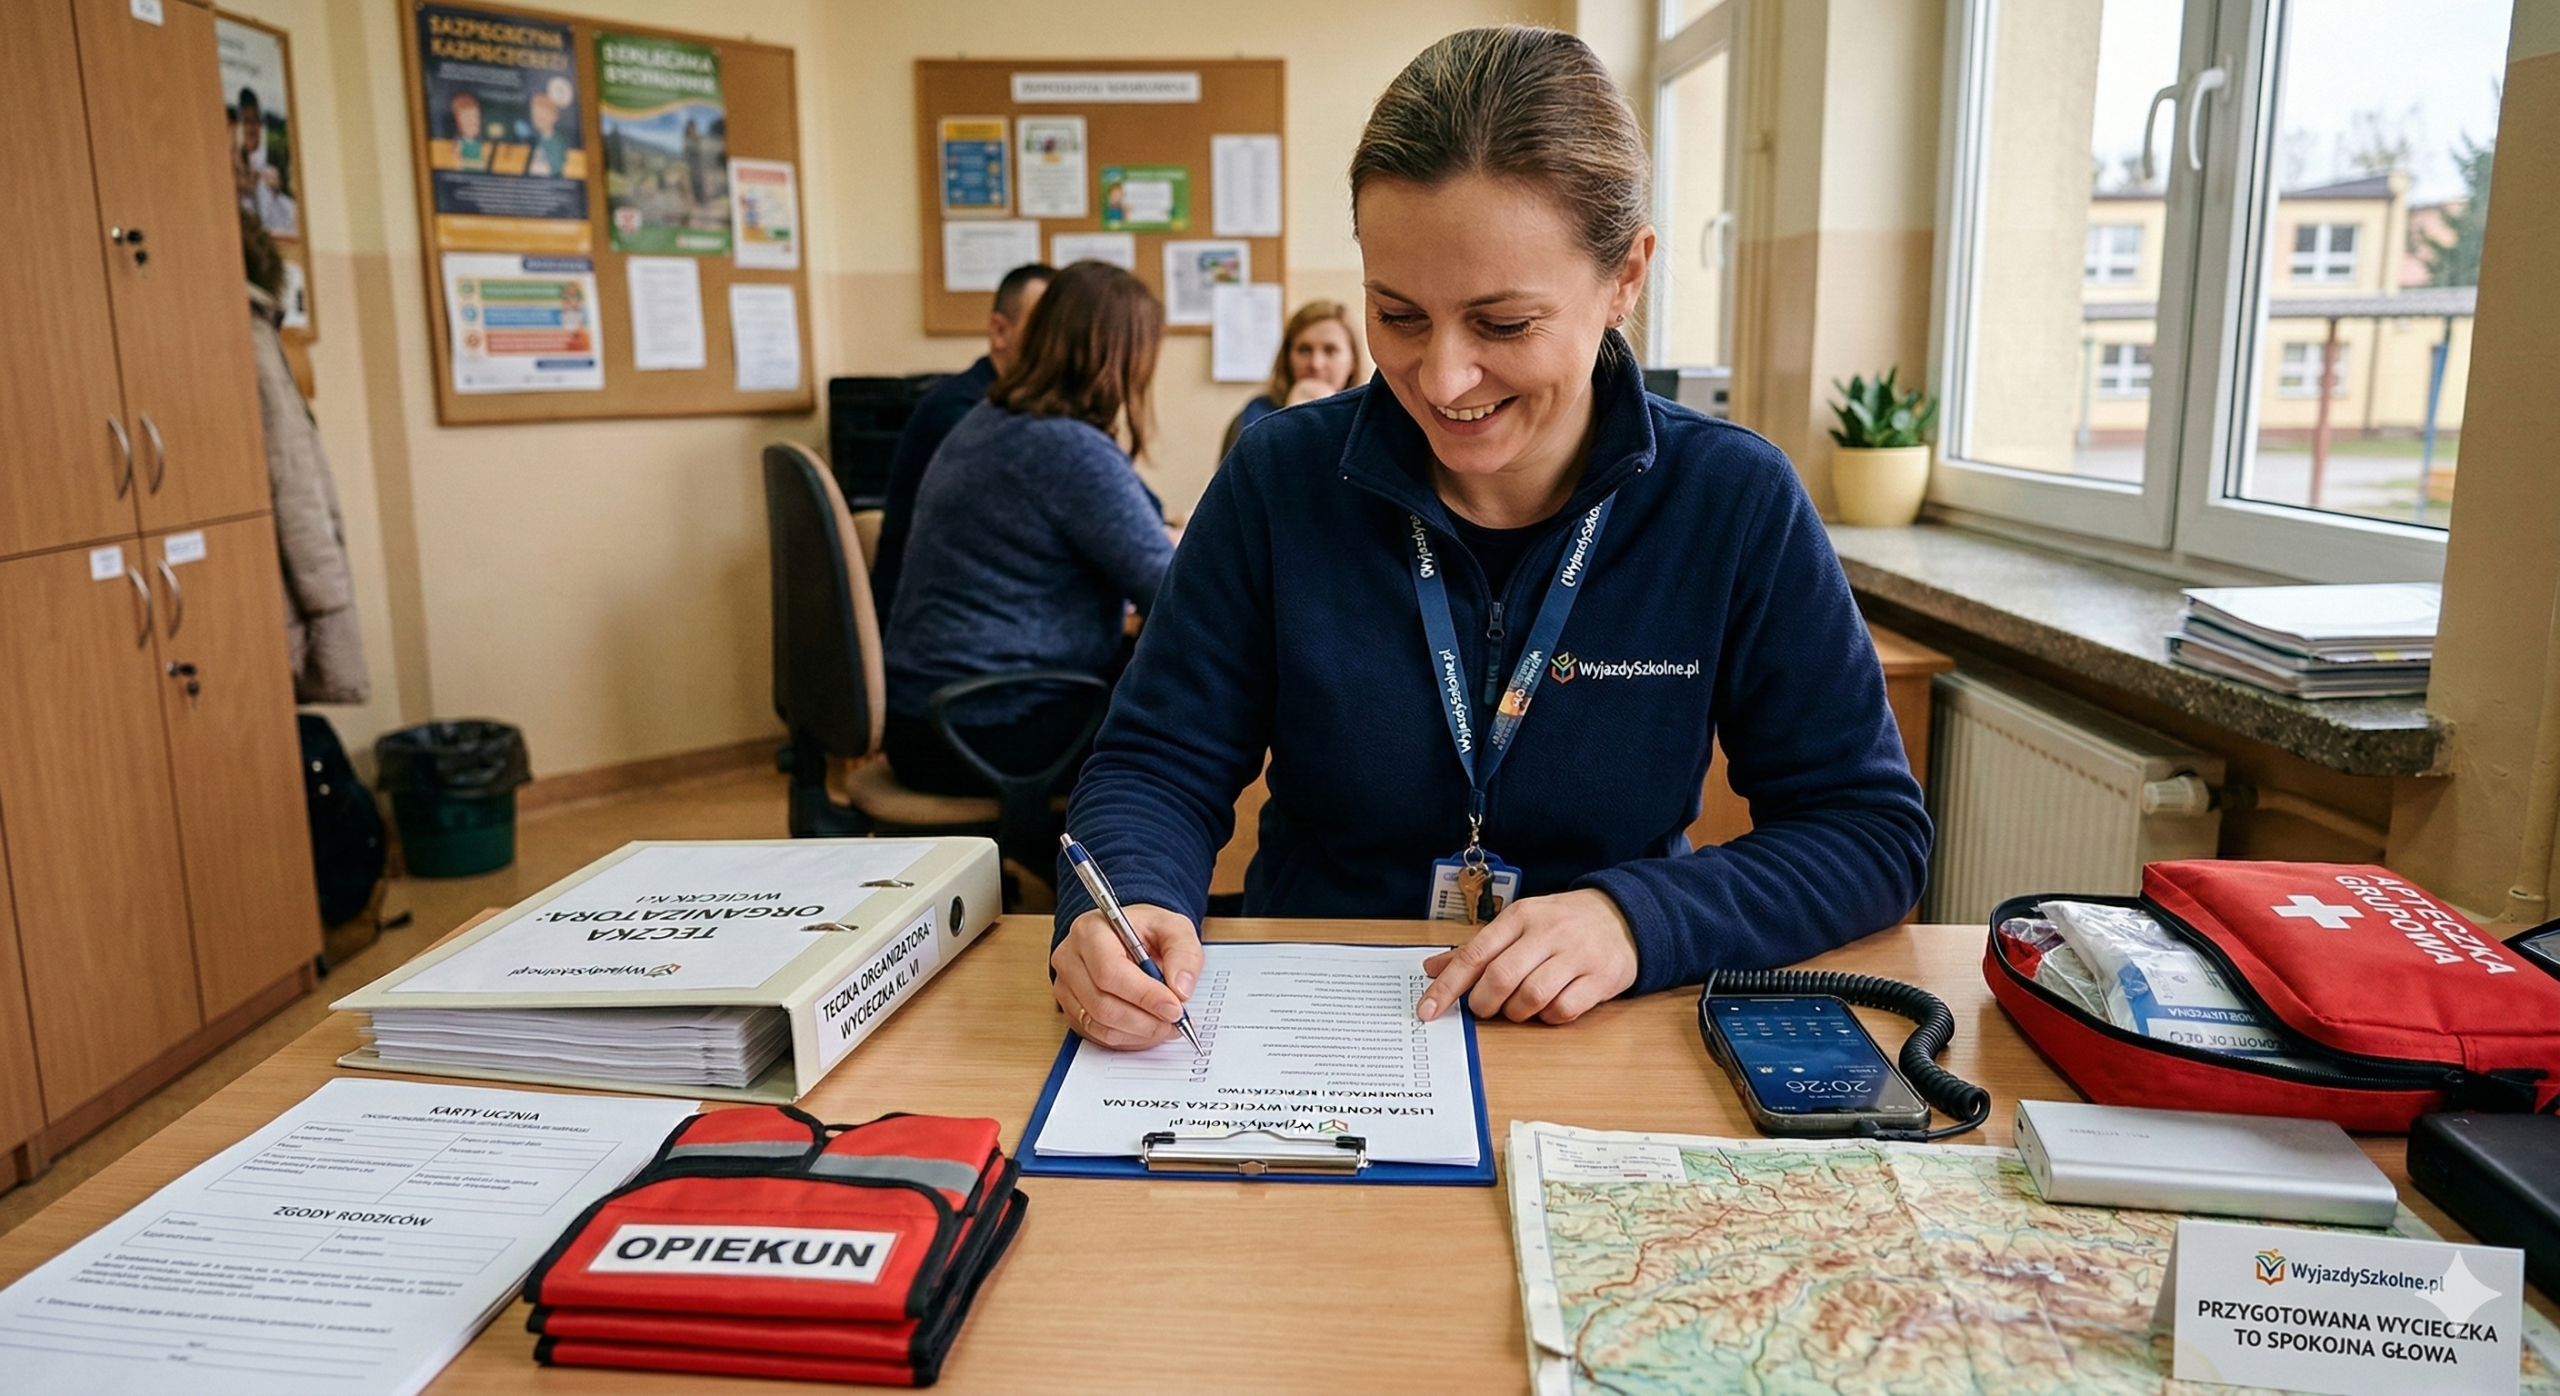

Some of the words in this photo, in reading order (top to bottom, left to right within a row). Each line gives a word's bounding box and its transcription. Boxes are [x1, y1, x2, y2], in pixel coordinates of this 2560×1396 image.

[1579, 658, 1700, 680] WyjazdySzkolne.pl
[2334, 875, 2465, 965] GRUPOWA
[2366, 874, 2518, 975] APTECZKA
[587, 926, 718, 941] TECZKA
[823, 981, 860, 1022] TECZKA
[840, 981, 895, 1040] WYCIECZKA
[909, 958, 920, 978] VI
[1786, 1079, 1872, 1093] 20:26
[429, 1106, 482, 1118] KARTY
[482, 1109, 541, 1121] UCZNIA
[1103, 1099, 1180, 1110] SZKOLNA
[1187, 1100, 1282, 1112] WYCIECZKA
[1388, 1106, 1434, 1116] LISTA
[273, 1205, 336, 1220] ZGODY
[336, 1209, 433, 1227] RODZICÓW
[616, 1236, 876, 1267] OPIEKUN
[2291, 1261, 2446, 1295] WyjazdySzkolne.pl
[2198, 1300, 2371, 1332] PRZYGOTOWANA
[2376, 1315, 2498, 1343] WYCIECZKA
[2234, 1328, 2262, 1348] TO
[2267, 1331, 2376, 1358] SPOKOJNA
[2382, 1341, 2458, 1365] GŁOWA
